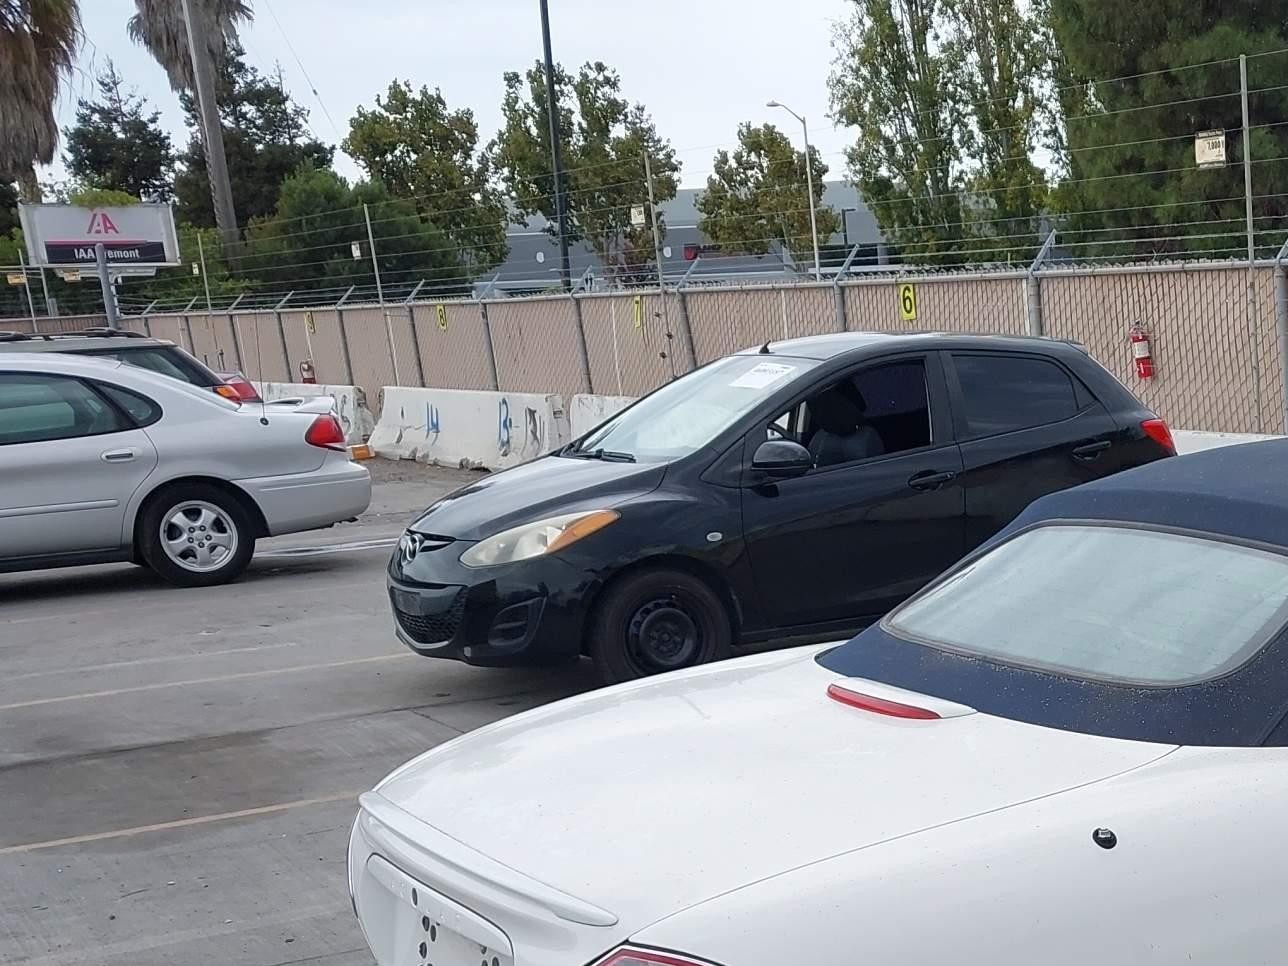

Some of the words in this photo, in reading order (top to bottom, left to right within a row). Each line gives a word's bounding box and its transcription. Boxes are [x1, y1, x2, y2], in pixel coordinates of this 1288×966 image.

[74, 248, 95, 259] IAA
[103, 248, 140, 259] remont
[902, 285, 913, 314] 6
[438, 308, 445, 327] 8
